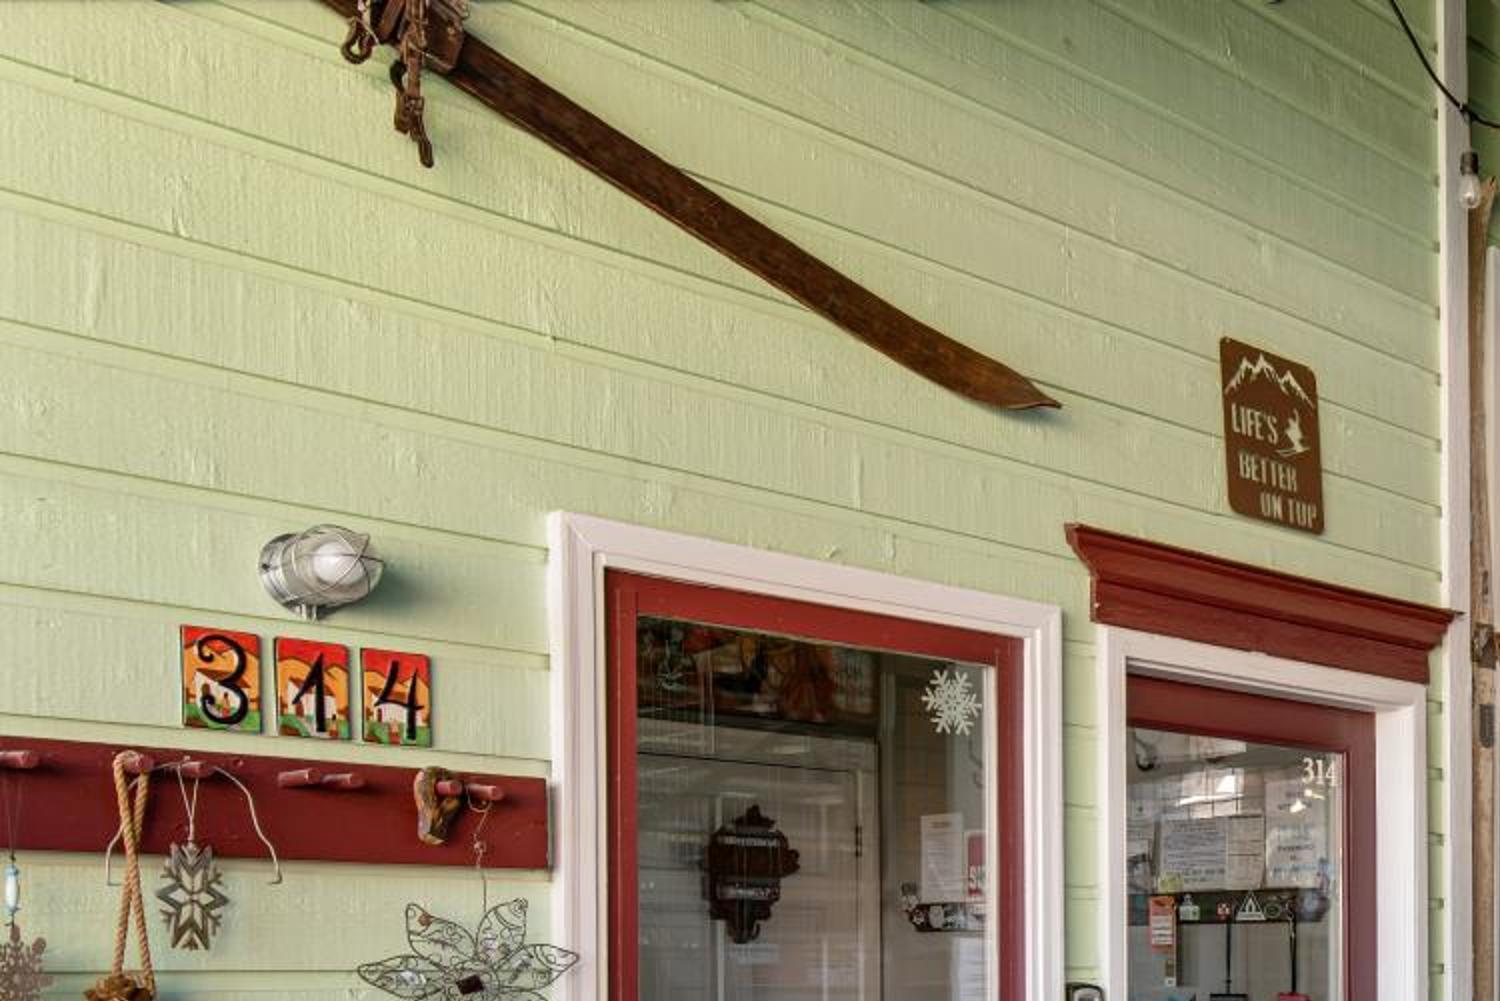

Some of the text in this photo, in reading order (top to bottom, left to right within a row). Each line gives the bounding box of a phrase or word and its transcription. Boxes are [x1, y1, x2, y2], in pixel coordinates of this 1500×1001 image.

[1231, 402, 1278, 444] LIFE'S
[1238, 450, 1298, 492] BETTER
[1260, 492, 1318, 529] ON TOP
[197, 634, 424, 740] 314
[1302, 757, 1338, 787] 314
